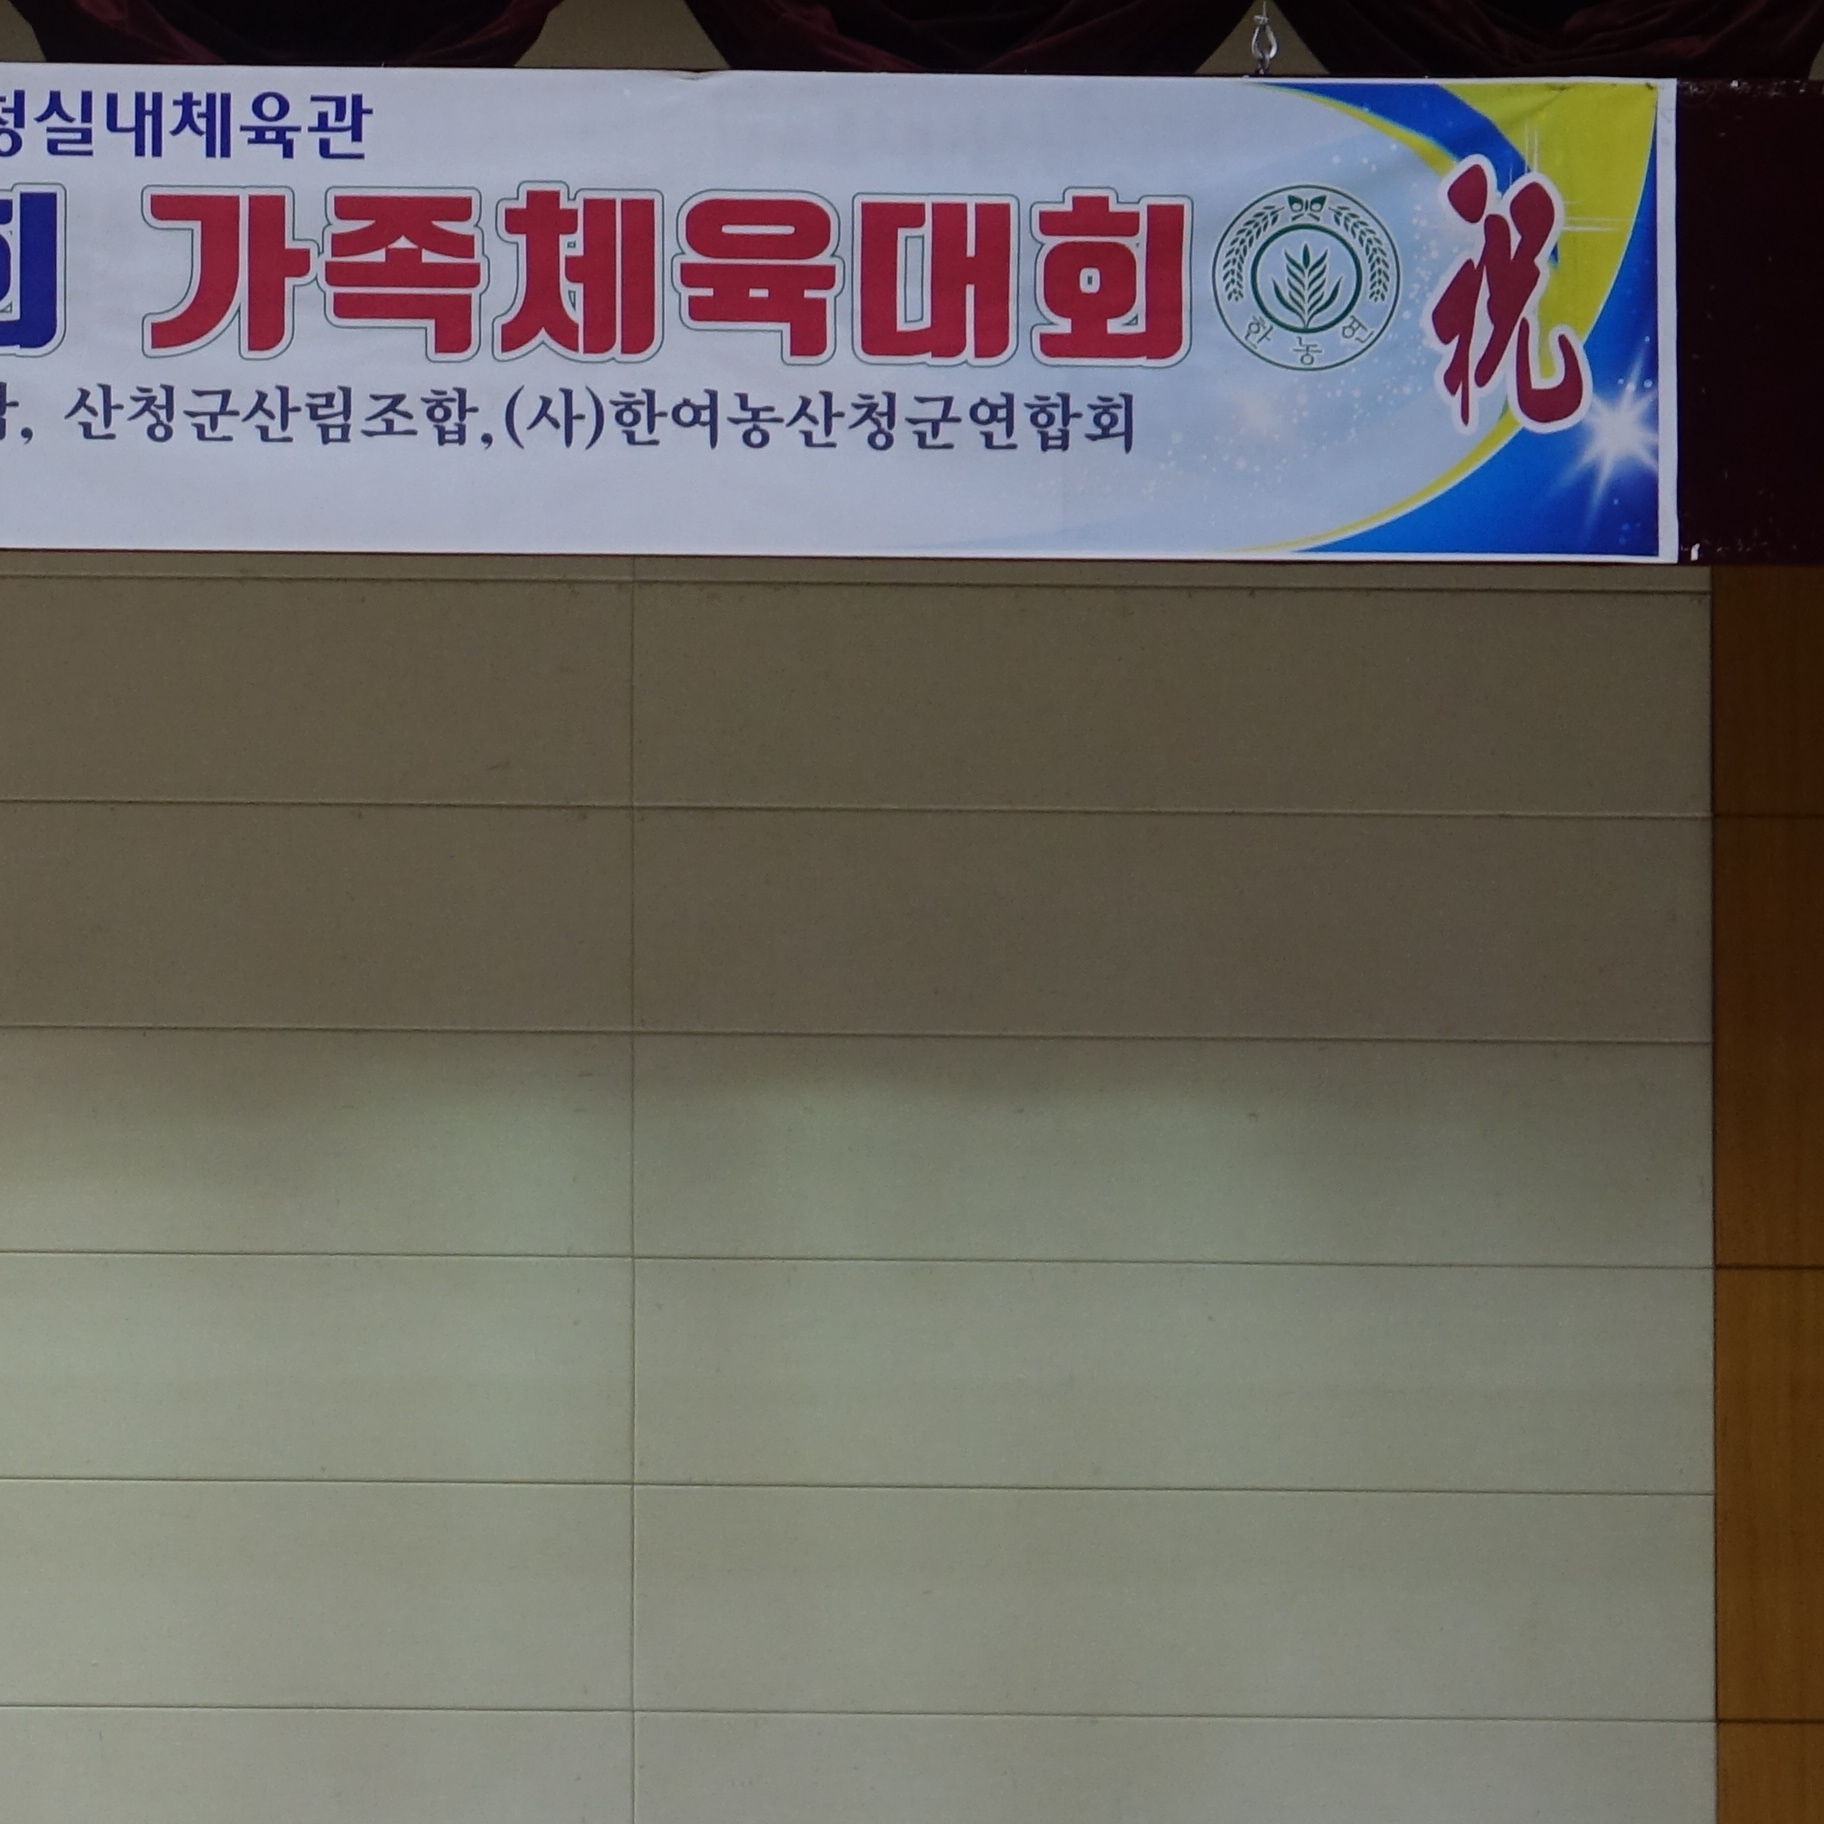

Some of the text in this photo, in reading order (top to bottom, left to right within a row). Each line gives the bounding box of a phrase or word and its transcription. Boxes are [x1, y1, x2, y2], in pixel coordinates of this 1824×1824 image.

[143, 186, 1186, 362] 가족체육대회
[1244, 311, 1370, 370] 한농연
[1431, 155, 1589, 430] 祝
